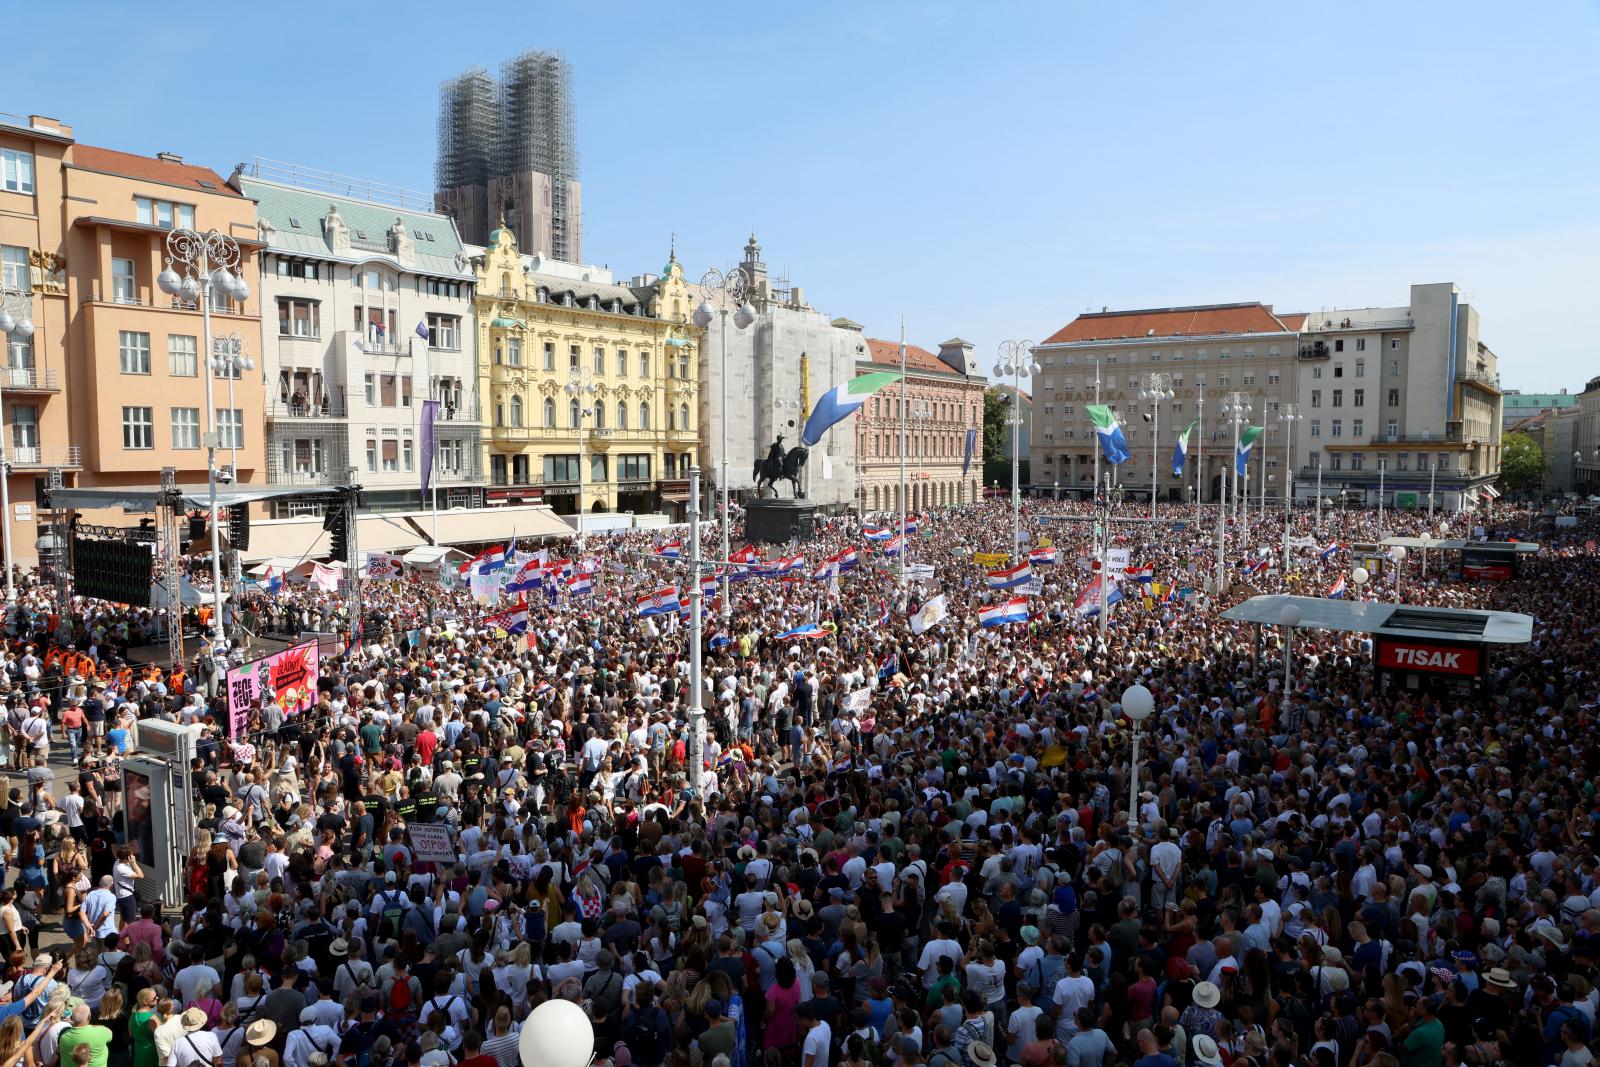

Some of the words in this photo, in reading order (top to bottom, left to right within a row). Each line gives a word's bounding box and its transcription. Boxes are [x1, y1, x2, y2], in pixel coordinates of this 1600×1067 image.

[369, 567, 393, 576] KAD?
[1394, 647, 1462, 669] TISAK
[420, 839, 448, 850] OTPOR
